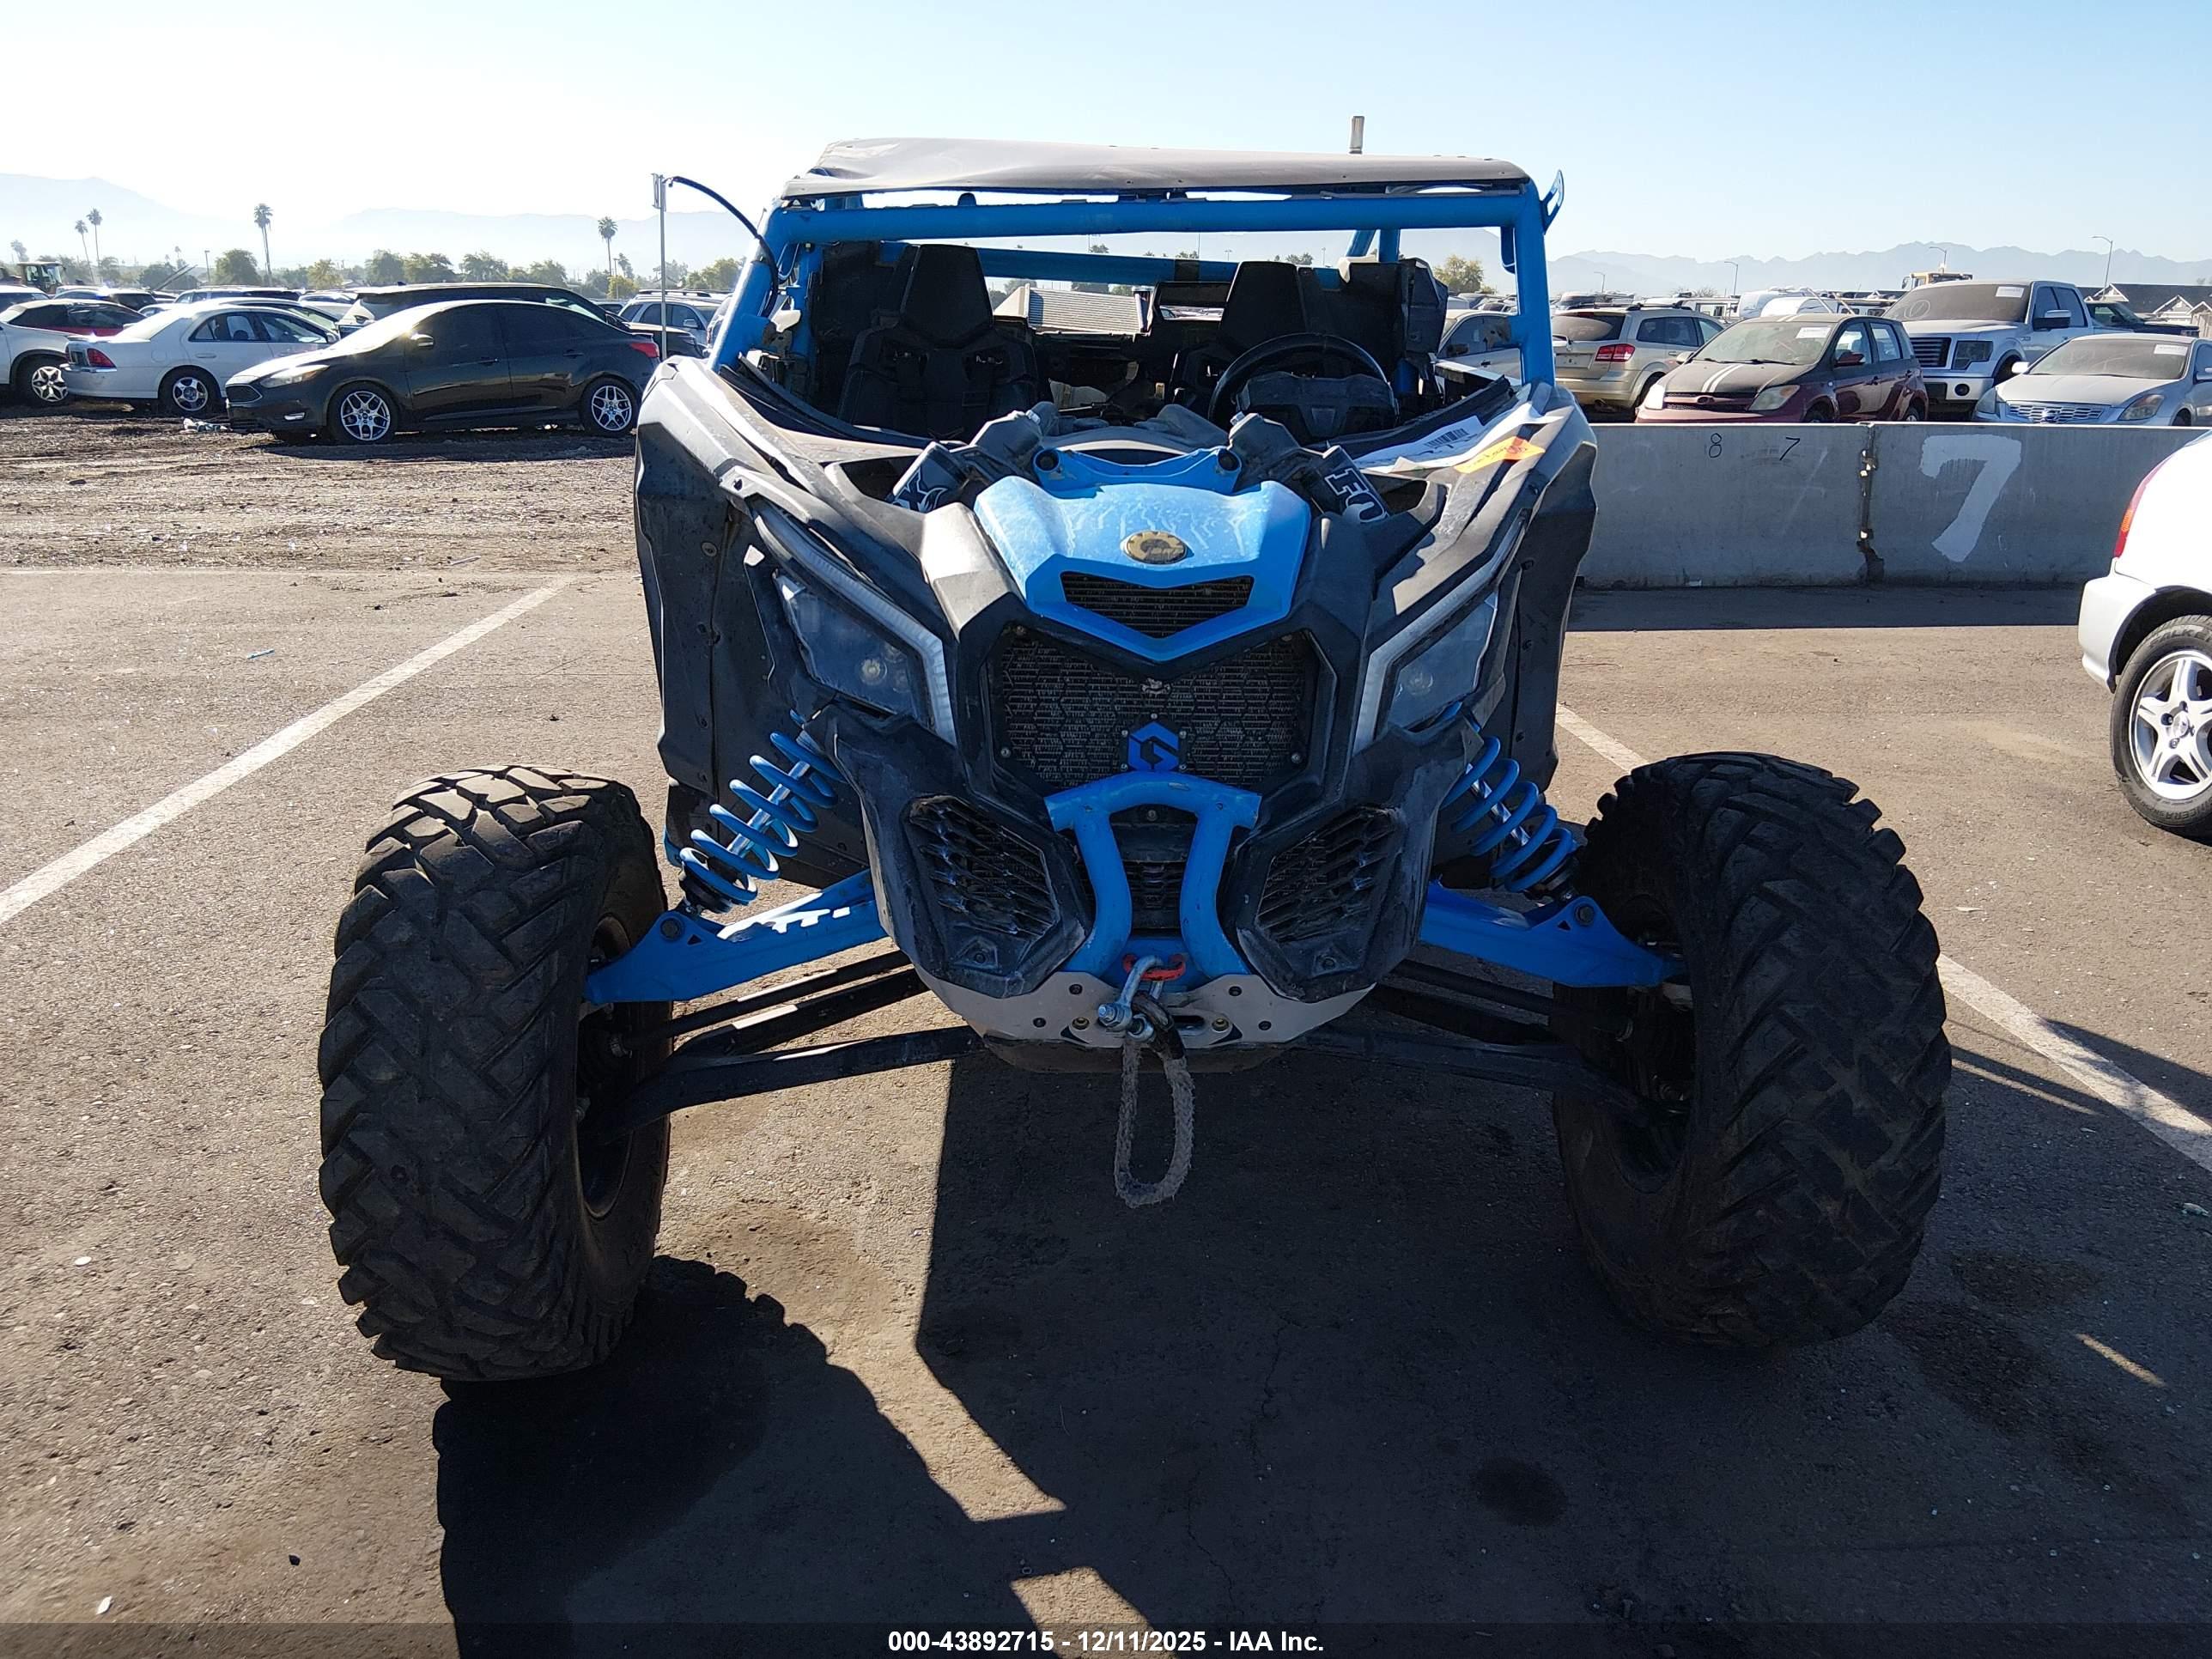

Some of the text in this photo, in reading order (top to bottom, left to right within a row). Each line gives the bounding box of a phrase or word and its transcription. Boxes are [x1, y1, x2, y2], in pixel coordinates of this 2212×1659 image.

[1707, 433, 1801, 461] 8 7
[1917, 434, 2022, 562] 7
